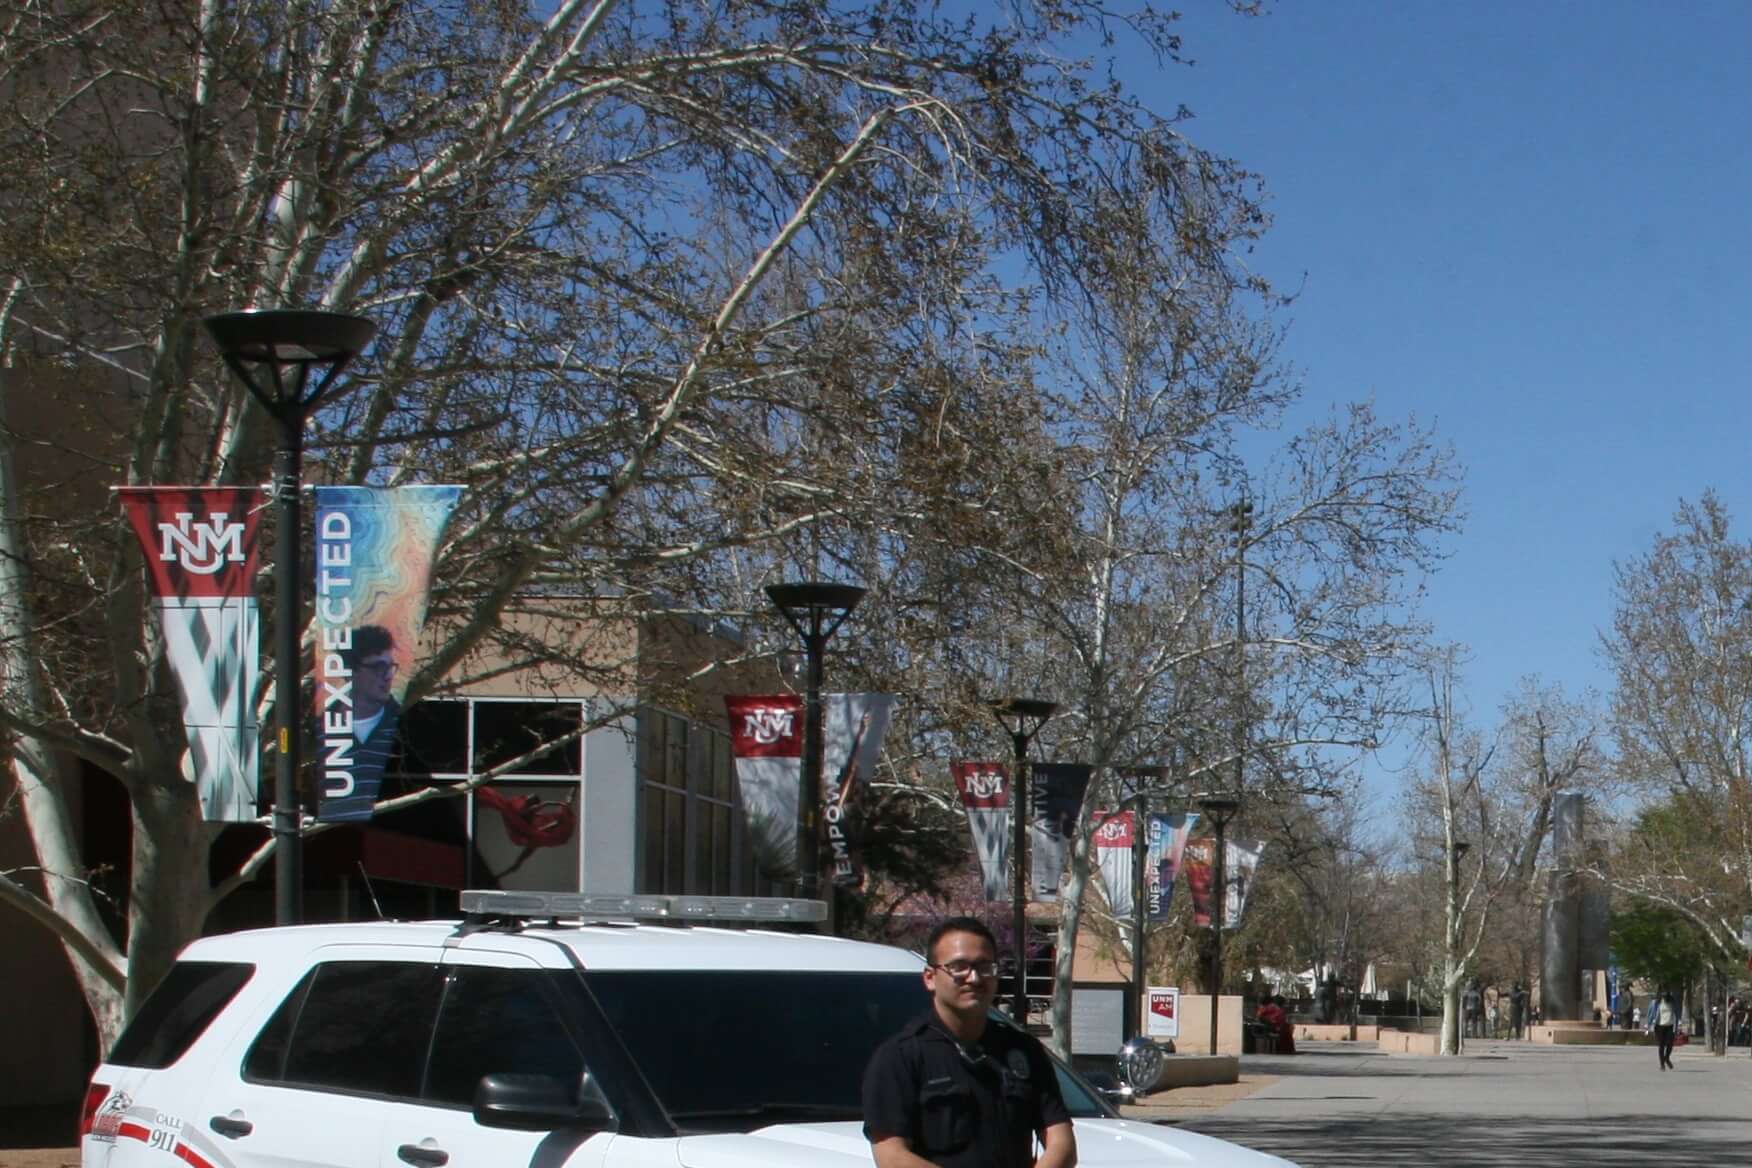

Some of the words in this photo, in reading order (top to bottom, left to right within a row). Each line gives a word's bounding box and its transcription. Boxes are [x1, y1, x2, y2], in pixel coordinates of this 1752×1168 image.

[321, 511, 355, 798] UNEXPECTED
[1150, 820, 1162, 914] UNEXPECTED
[150, 1129, 175, 1153] 911
[156, 1113, 180, 1129] CALL
